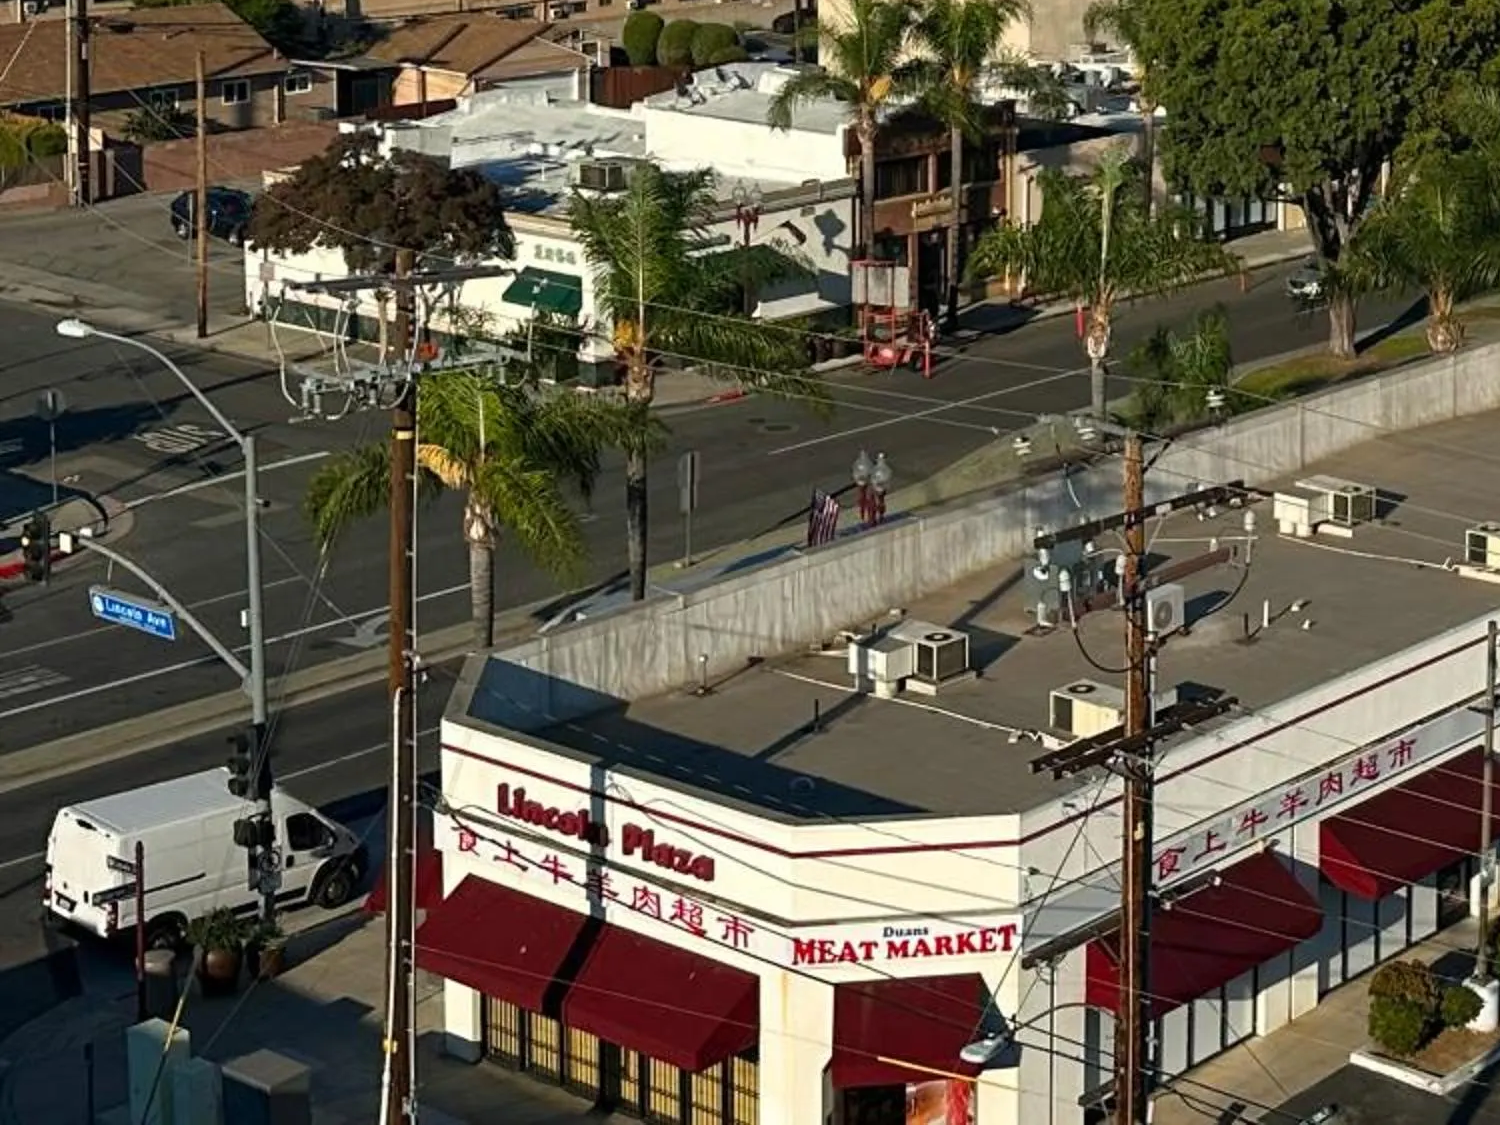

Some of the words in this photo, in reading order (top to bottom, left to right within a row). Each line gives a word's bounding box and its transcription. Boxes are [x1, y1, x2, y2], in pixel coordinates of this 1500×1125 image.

[497, 781, 610, 848] Lincoln
[622, 822, 716, 882] Plaza
[1151, 737, 1418, 881] 食上牛羊肉超市
[792, 937, 879, 966] MEAT
[886, 922, 1018, 961] MARKET
[883, 926, 929, 939] Duans
